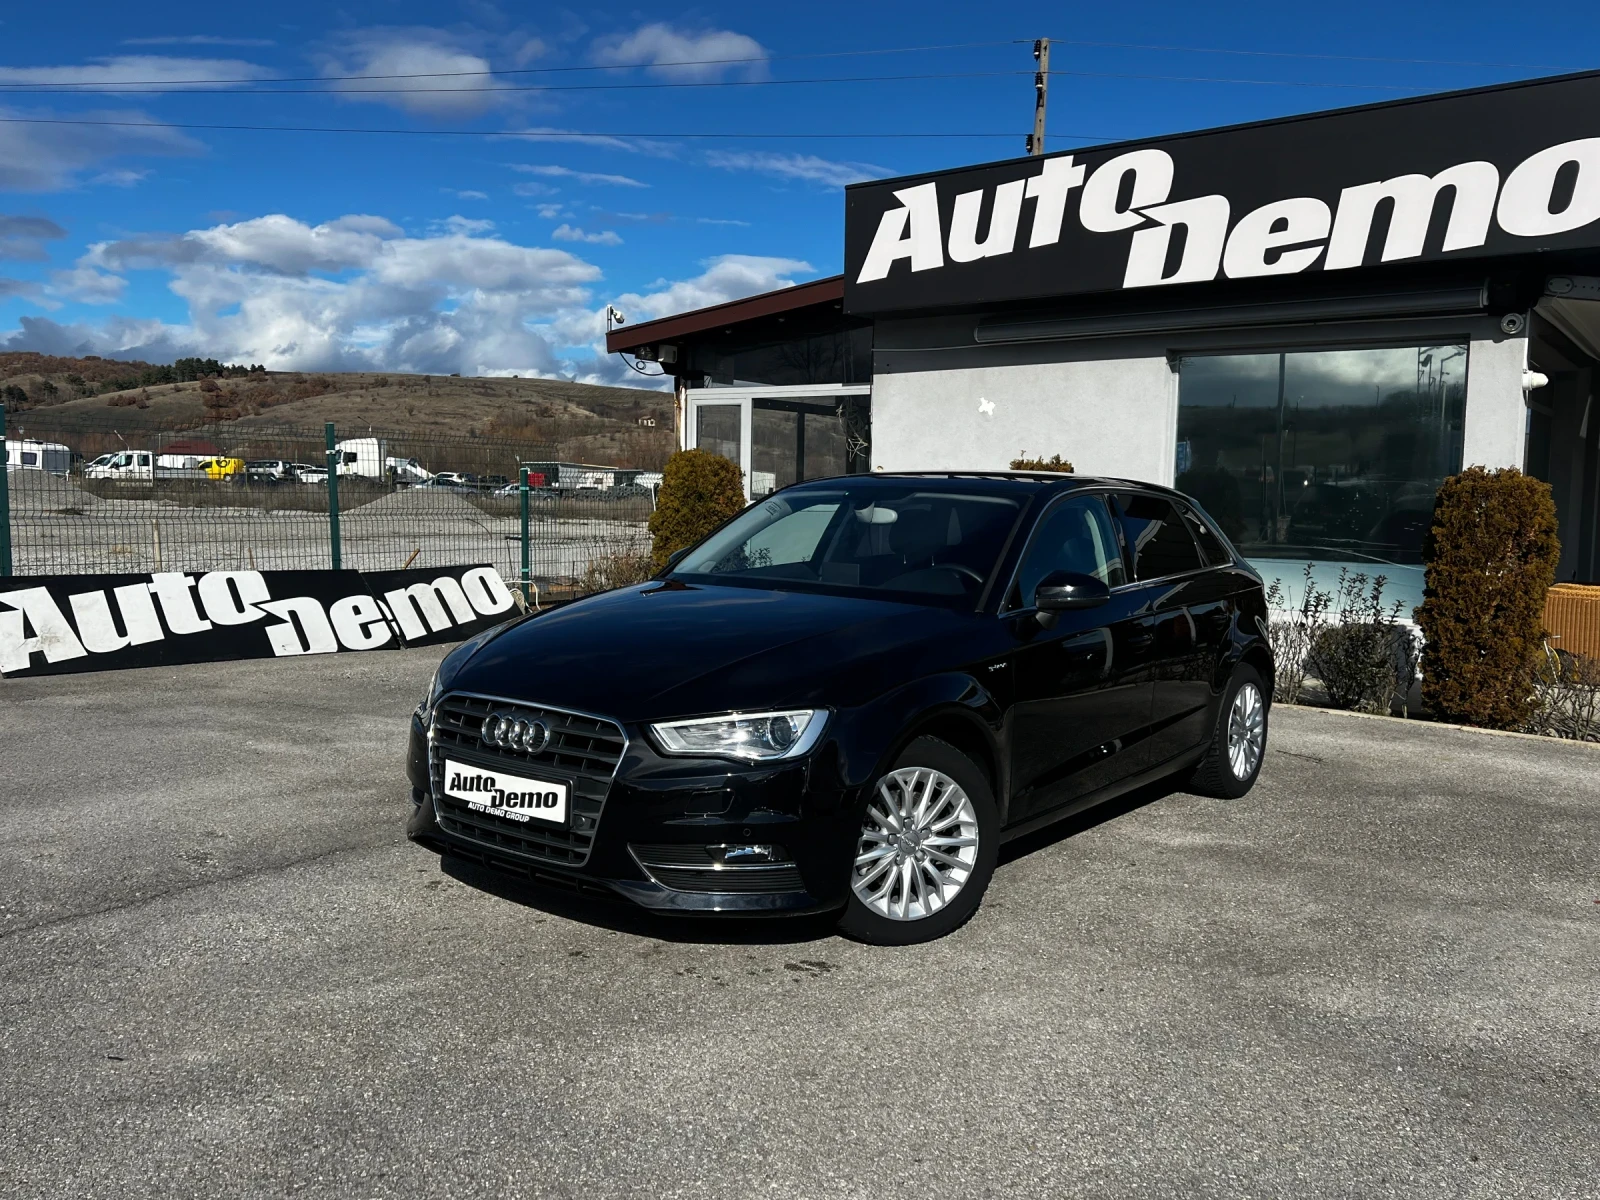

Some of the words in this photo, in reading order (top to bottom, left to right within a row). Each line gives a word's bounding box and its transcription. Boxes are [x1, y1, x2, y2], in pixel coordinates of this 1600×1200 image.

[857, 149, 1175, 284] Auto
[1123, 137, 1600, 288] Demo
[0, 570, 271, 673] Auto
[257, 567, 515, 657] Demo
[449, 772, 496, 792] Auto
[490, 788, 558, 808] Demo
[468, 801, 485, 812] AUTO
[485, 806, 505, 817] DEMO
[505, 811, 530, 822] GROUP
